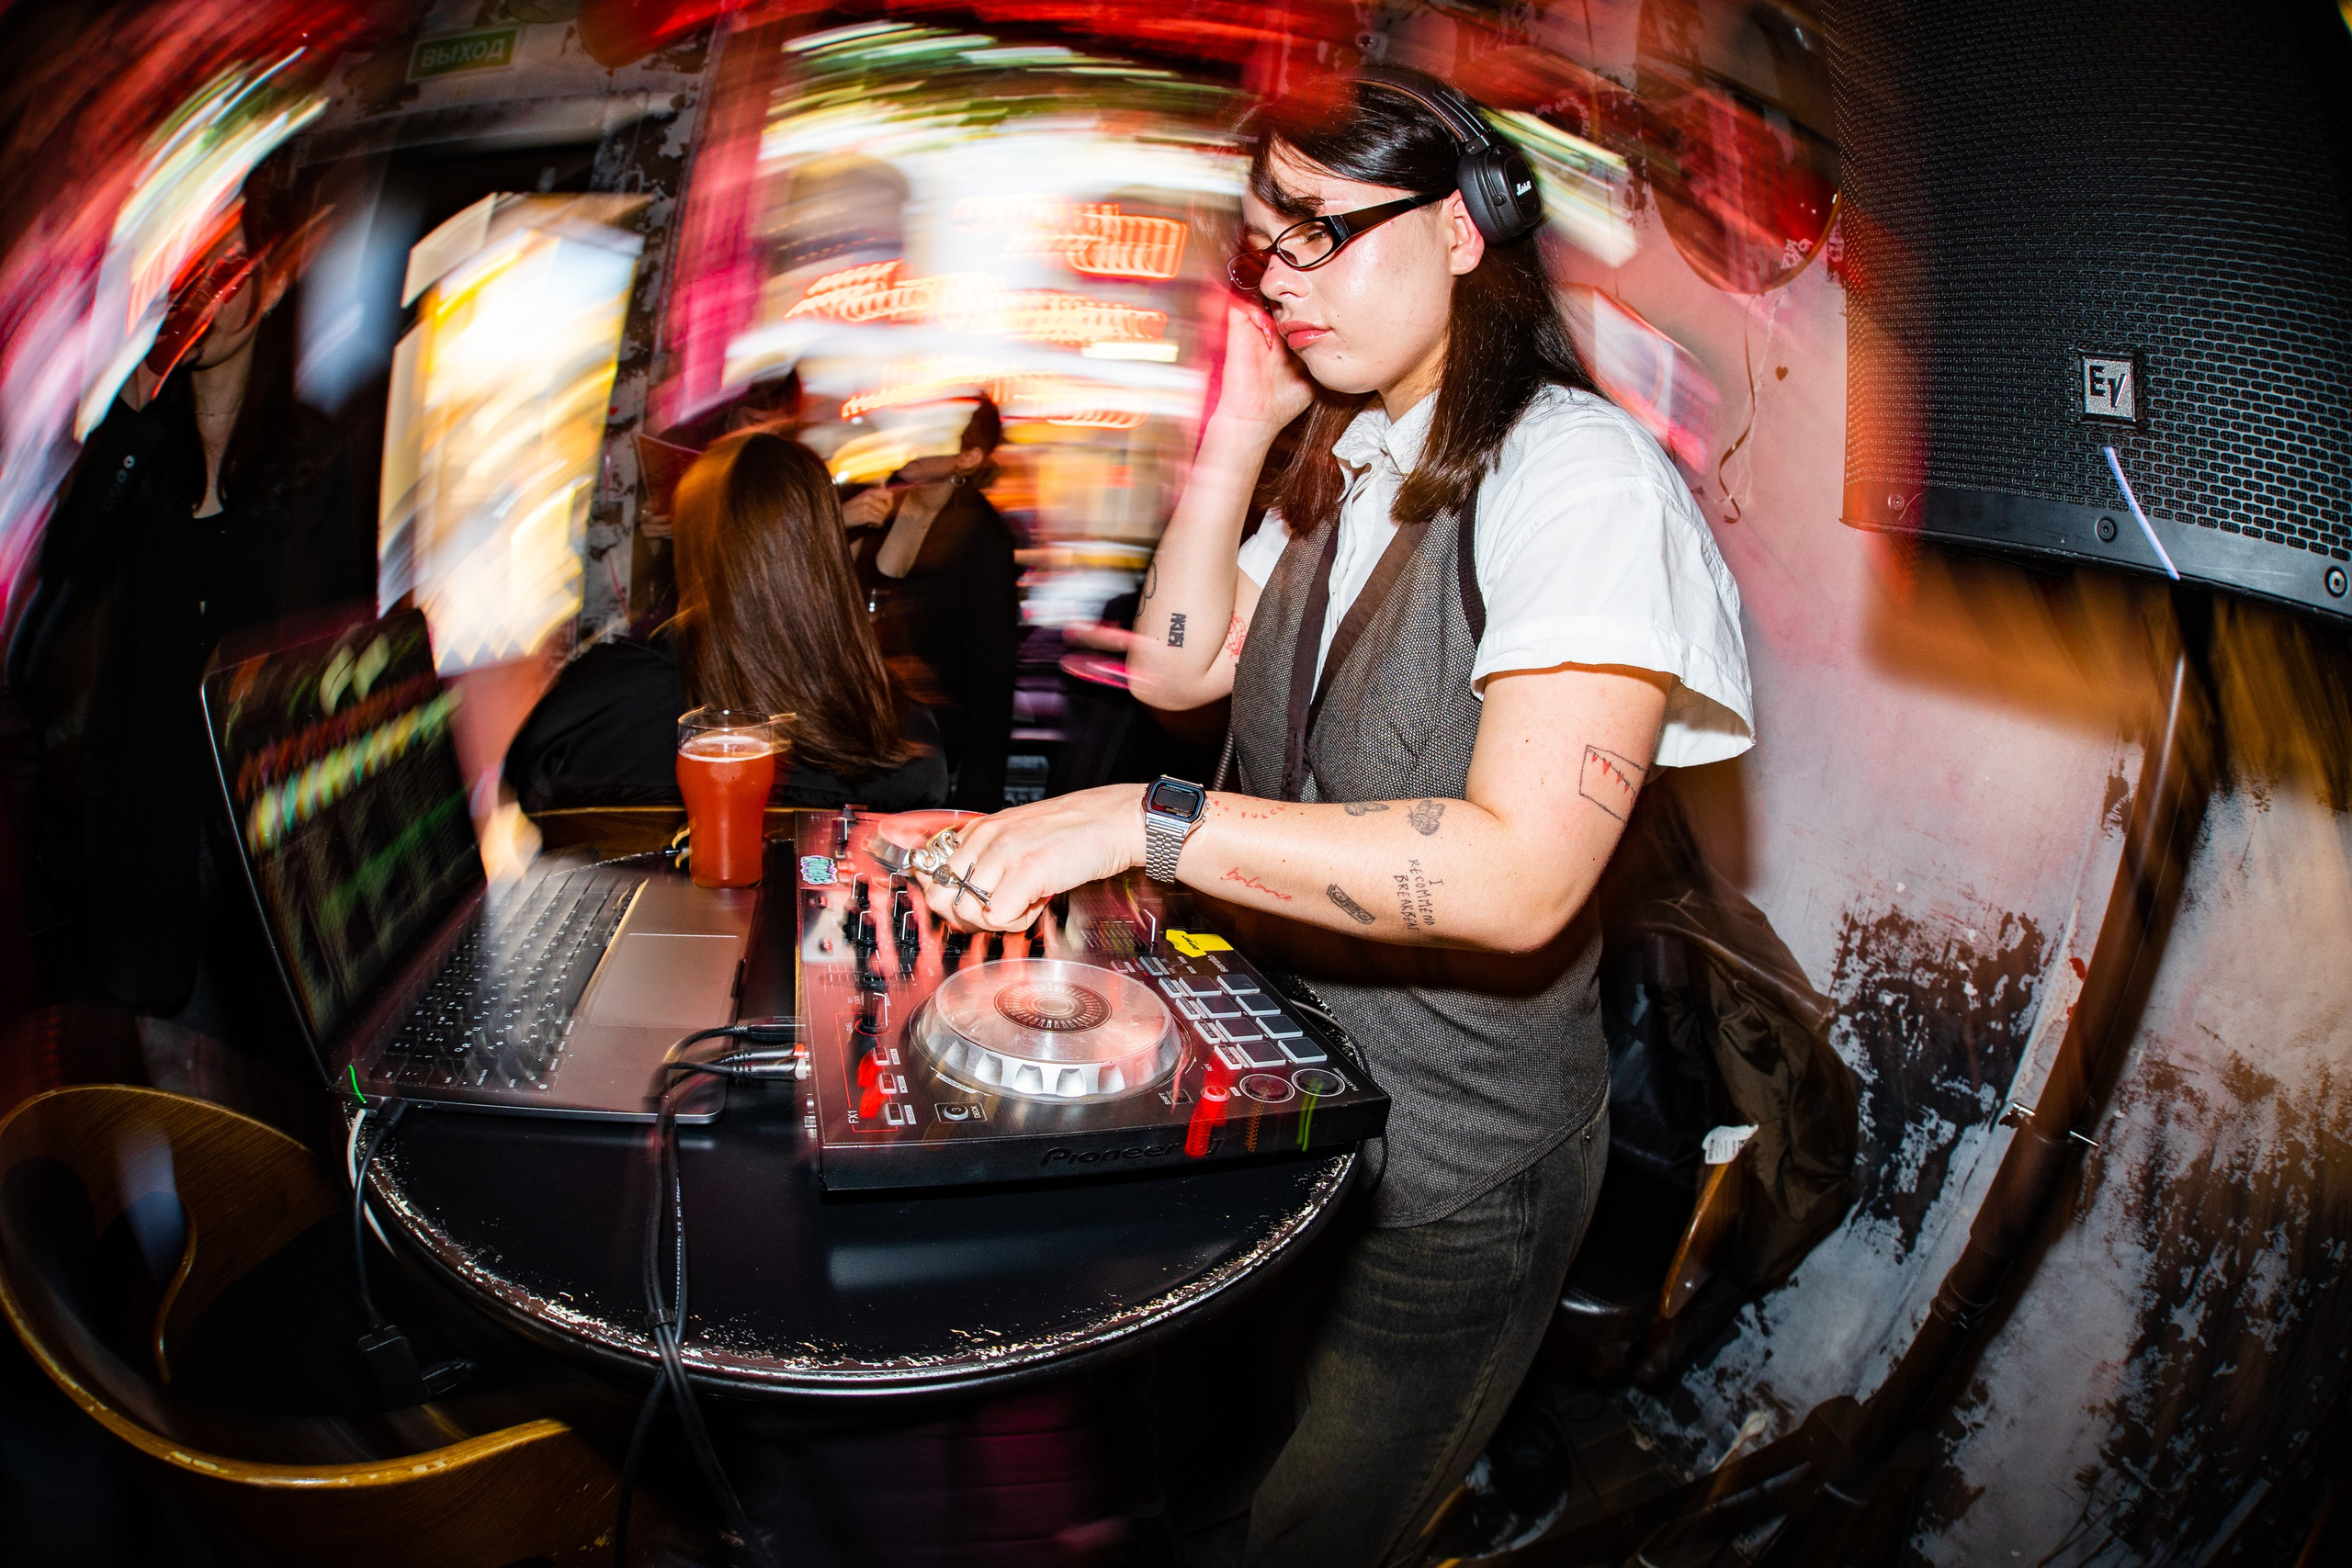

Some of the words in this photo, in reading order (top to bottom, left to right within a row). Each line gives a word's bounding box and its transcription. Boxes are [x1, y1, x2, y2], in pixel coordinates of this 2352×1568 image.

[421, 38, 506, 68] ВЫХОД
[1221, 867, 1293, 901] balance
[1408, 859, 1435, 926] RECOMMEND
[1393, 874, 1419, 932] BREAKBEAT
[847, 1110, 859, 1124] FX1
[972, 1105, 981, 1119] DECK
[1040, 1143, 1182, 1167] Pioneer
